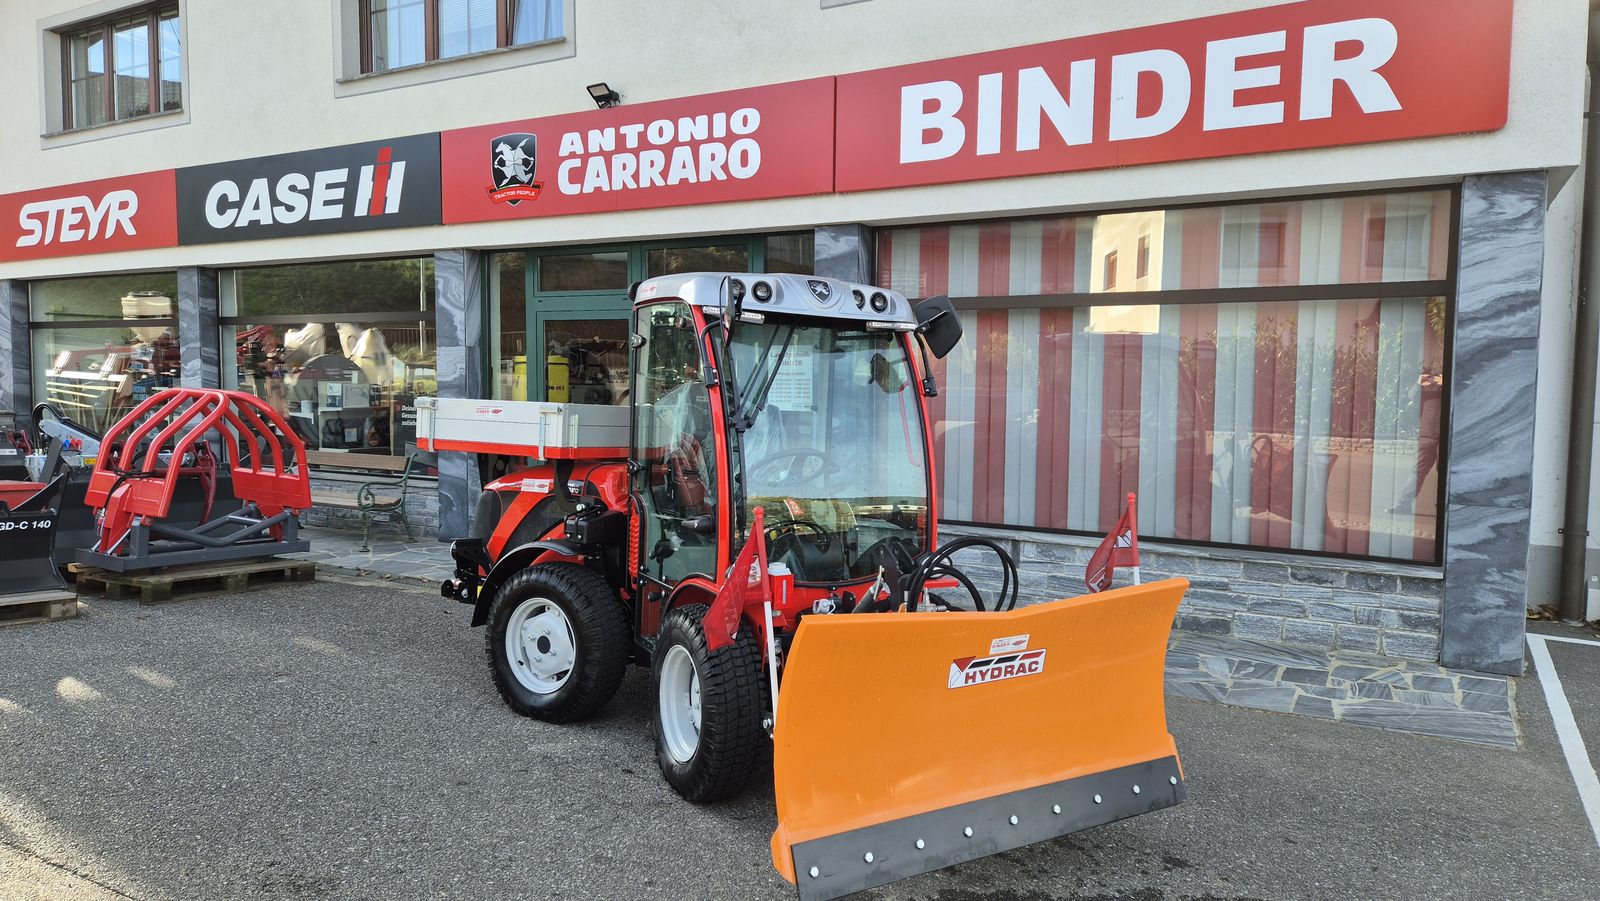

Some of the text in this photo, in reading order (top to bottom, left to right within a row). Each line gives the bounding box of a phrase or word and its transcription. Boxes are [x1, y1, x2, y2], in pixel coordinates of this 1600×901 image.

[900, 17, 1403, 164] BINDER
[558, 107, 762, 157] ANTONIO
[557, 138, 762, 195] CARRARO
[15, 189, 139, 248] STEYR
[205, 167, 348, 229] CASE
[494, 189, 536, 200] TRACTOR PEOPLE
[32, 520, 51, 529] 140
[964, 660, 1040, 684] HYDRAC
